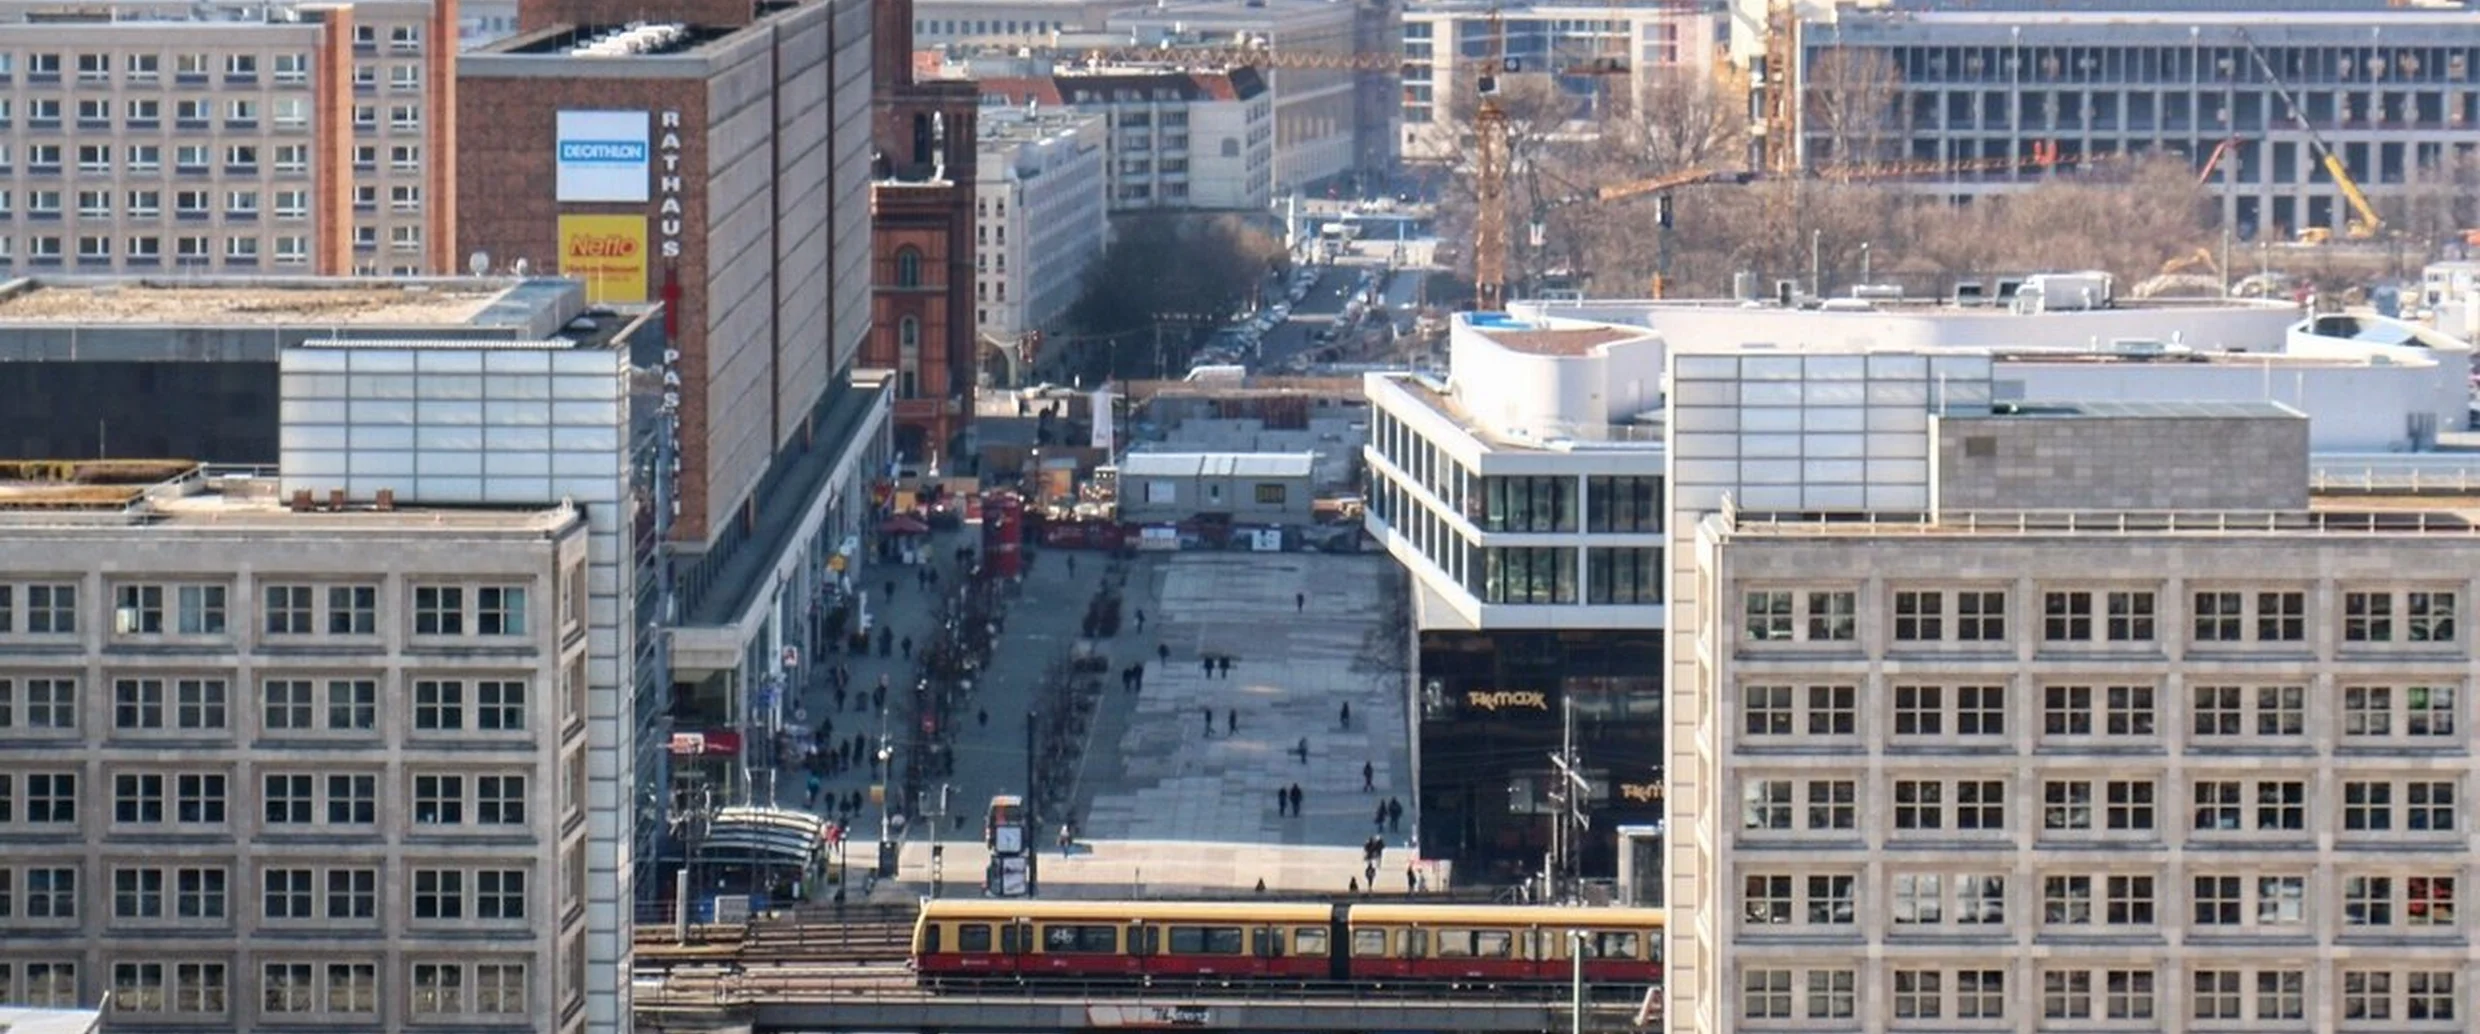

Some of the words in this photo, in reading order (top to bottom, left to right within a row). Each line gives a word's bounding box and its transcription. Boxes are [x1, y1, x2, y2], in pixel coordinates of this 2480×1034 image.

[563, 144, 643, 159] DECATHLON
[661, 111, 680, 257] RATHAUS
[569, 235, 638, 256] Netto
